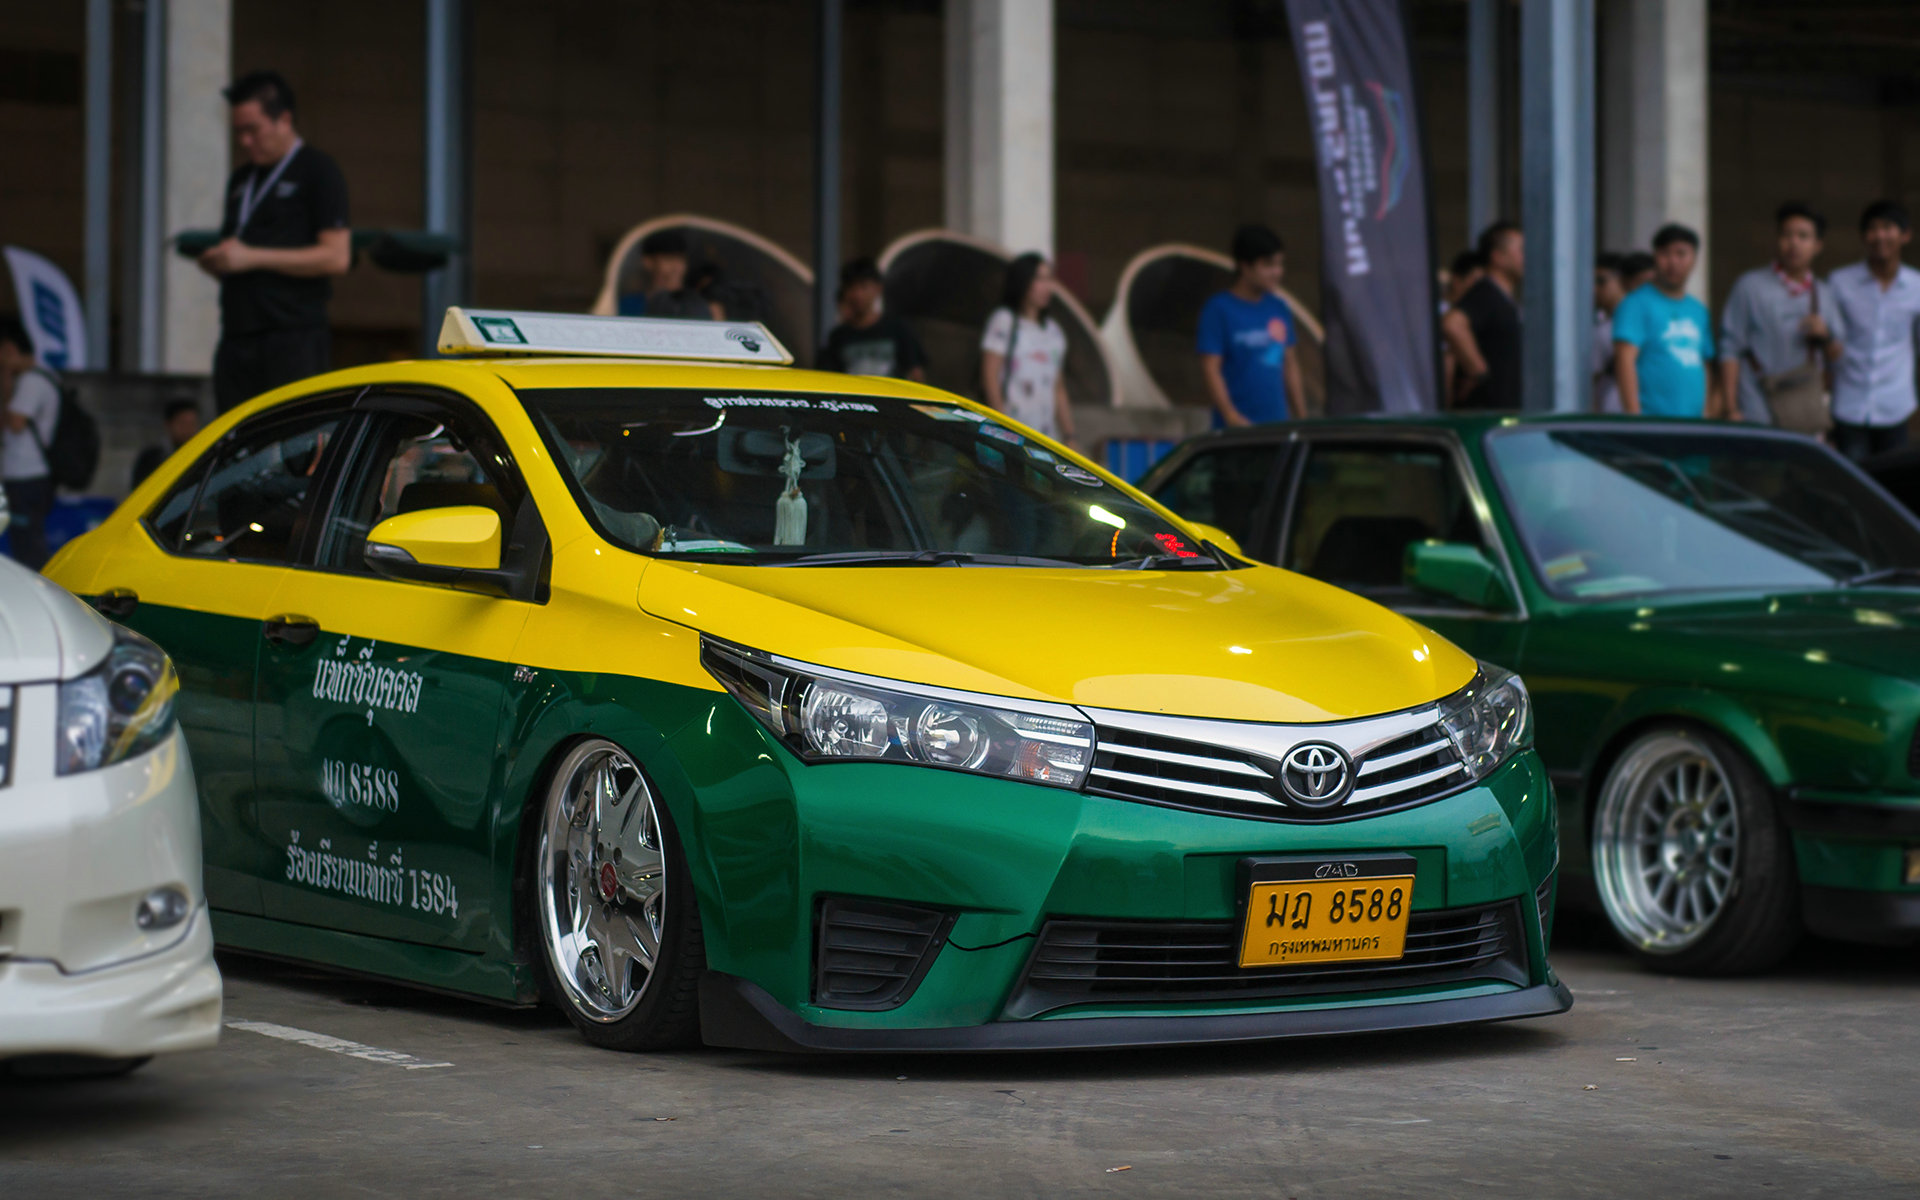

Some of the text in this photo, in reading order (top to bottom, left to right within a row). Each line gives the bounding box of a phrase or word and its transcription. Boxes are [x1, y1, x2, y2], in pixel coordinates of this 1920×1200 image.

[350, 762, 399, 813] 8588
[408, 868, 459, 919] 1584
[1266, 887, 1403, 929] มฎ 8588
[1268, 935, 1380, 960] กรุงเทพมหานคร
